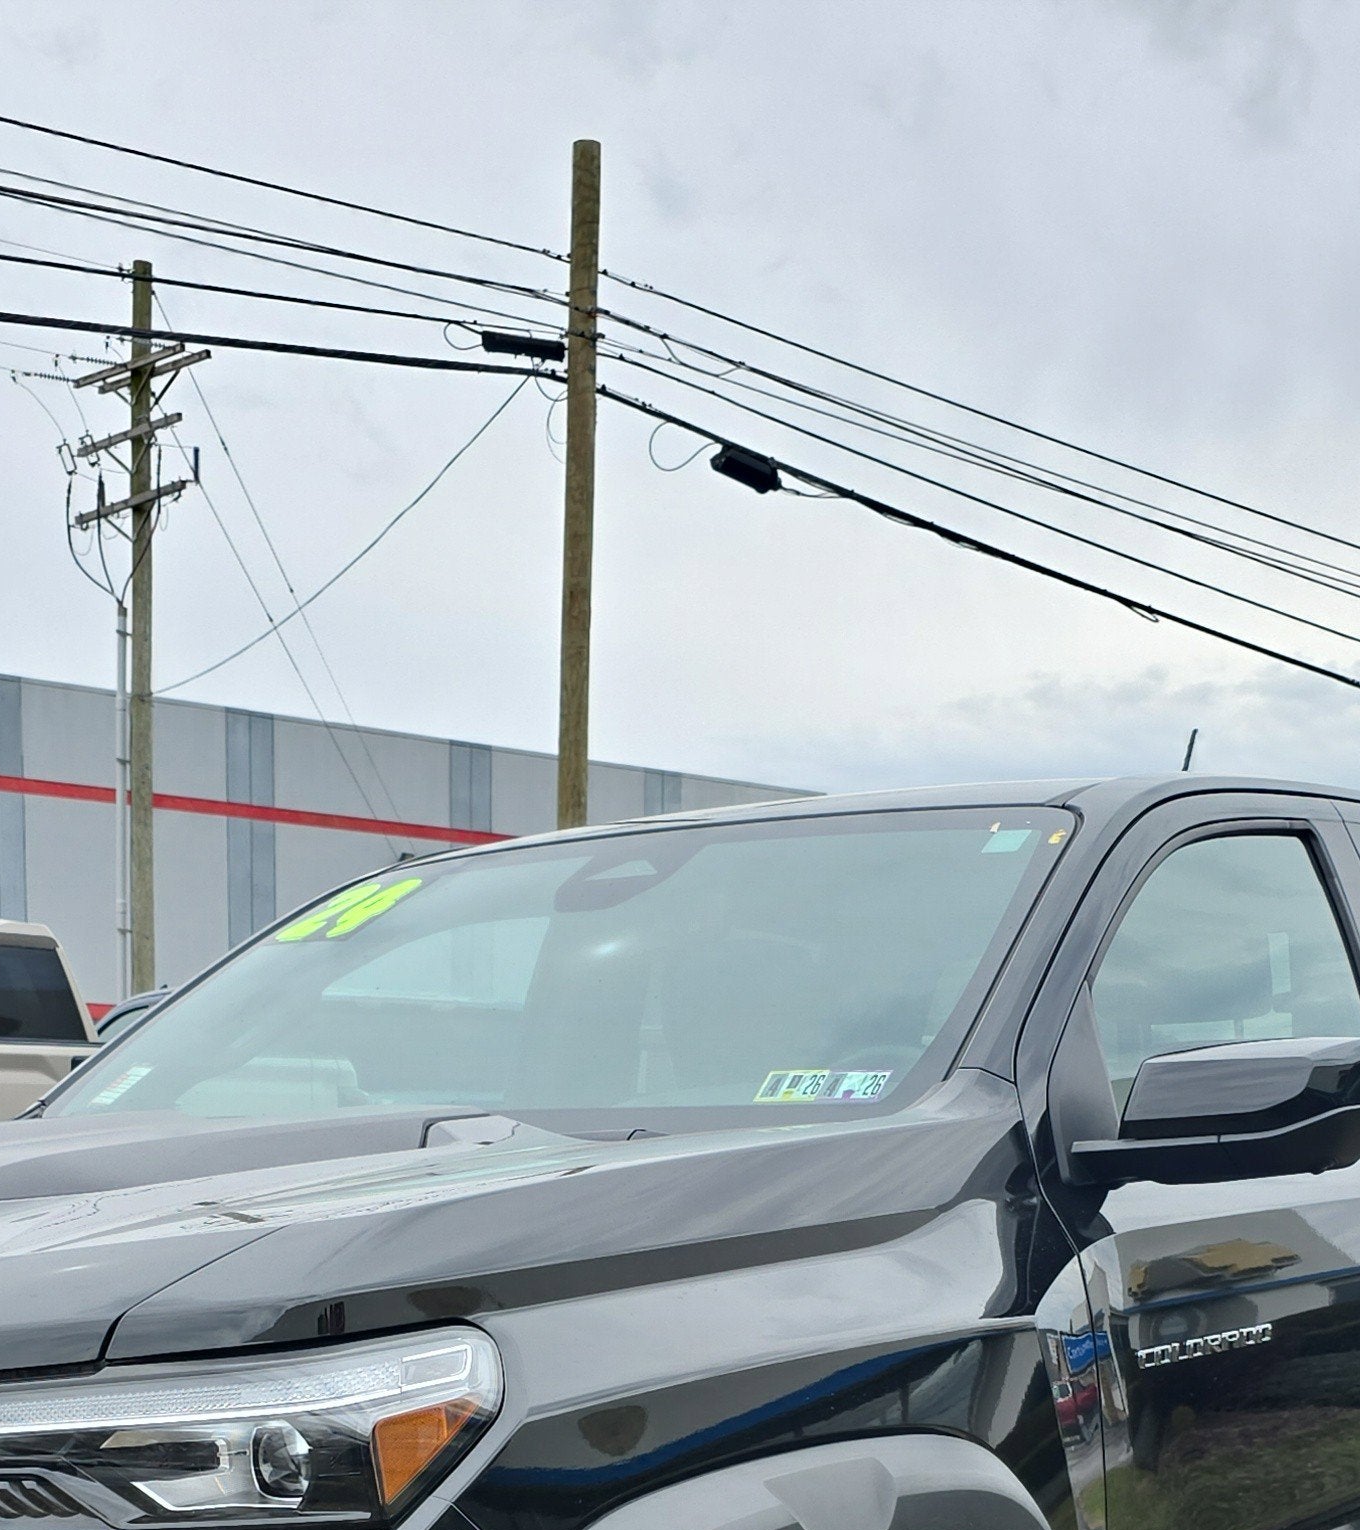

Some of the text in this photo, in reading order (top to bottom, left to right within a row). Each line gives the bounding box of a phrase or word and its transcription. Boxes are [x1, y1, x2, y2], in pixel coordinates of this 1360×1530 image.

[802, 1074, 827, 1096] 26
[862, 1074, 887, 1096] 26
[1137, 1323, 1273, 1369] COLORADO
